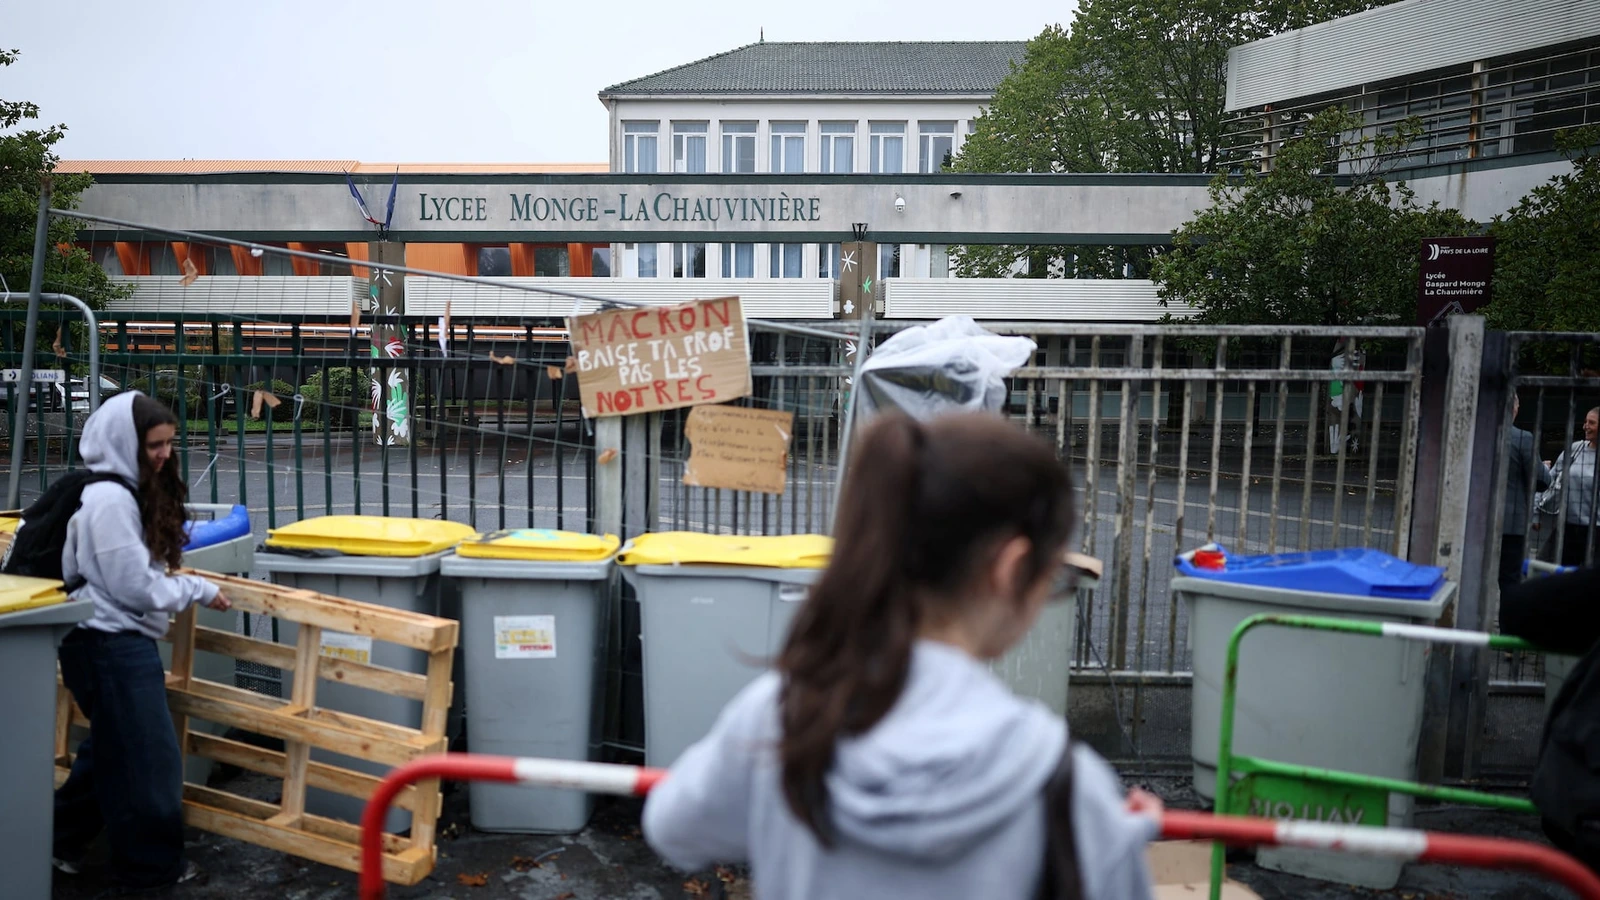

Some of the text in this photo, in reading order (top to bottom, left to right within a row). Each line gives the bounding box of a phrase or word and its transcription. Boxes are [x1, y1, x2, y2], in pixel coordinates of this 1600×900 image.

[1425, 272, 1446, 280] Lycée
[1459, 280, 1486, 288] Monge
[582, 301, 731, 346] MACRON
[577, 326, 735, 372] BAISE TA PROF
[618, 356, 702, 386] PAS LES
[596, 374, 717, 414] NOTRES
